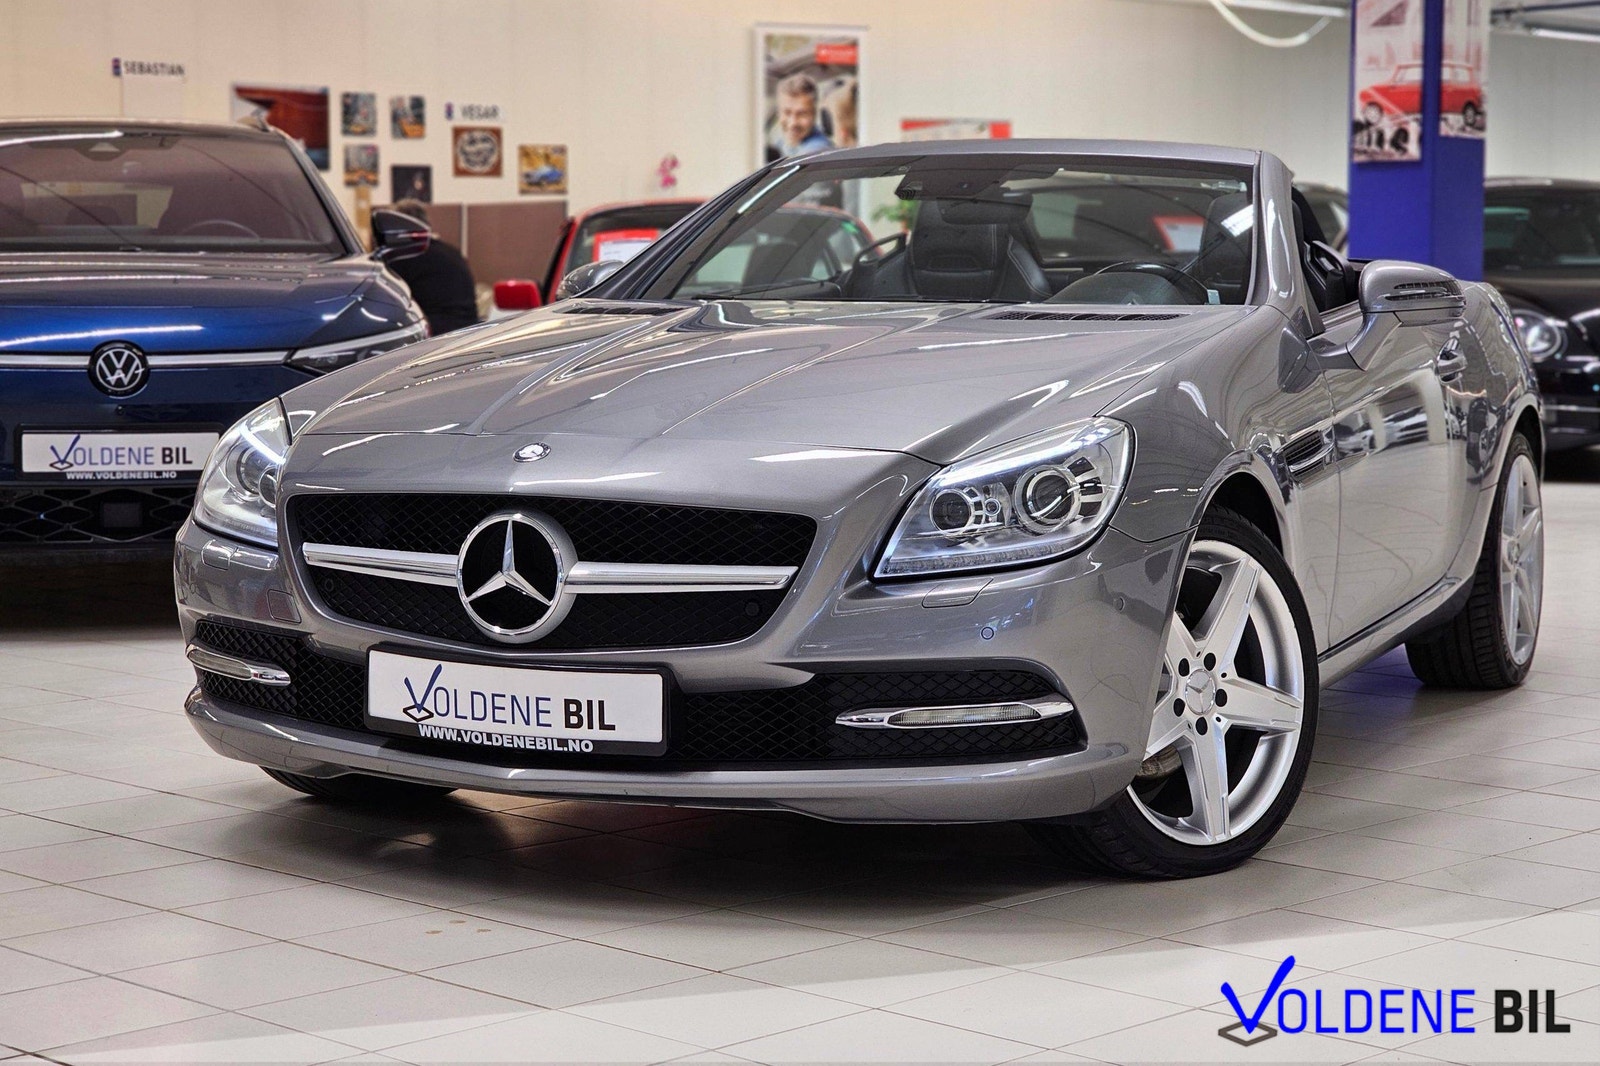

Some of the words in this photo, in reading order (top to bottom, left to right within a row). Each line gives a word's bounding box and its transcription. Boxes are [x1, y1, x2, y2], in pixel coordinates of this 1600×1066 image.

[123, 60, 185, 76] SEBASTIAN
[50, 434, 154, 466] VOLDENE
[161, 447, 193, 464] BIL
[66, 471, 177, 480] WWW.VOLDENEBIL.NO
[404, 663, 552, 728] VOLDENE
[563, 698, 616, 731] BIL
[418, 723, 594, 753] WWW.VOLDENEBIL.NO
